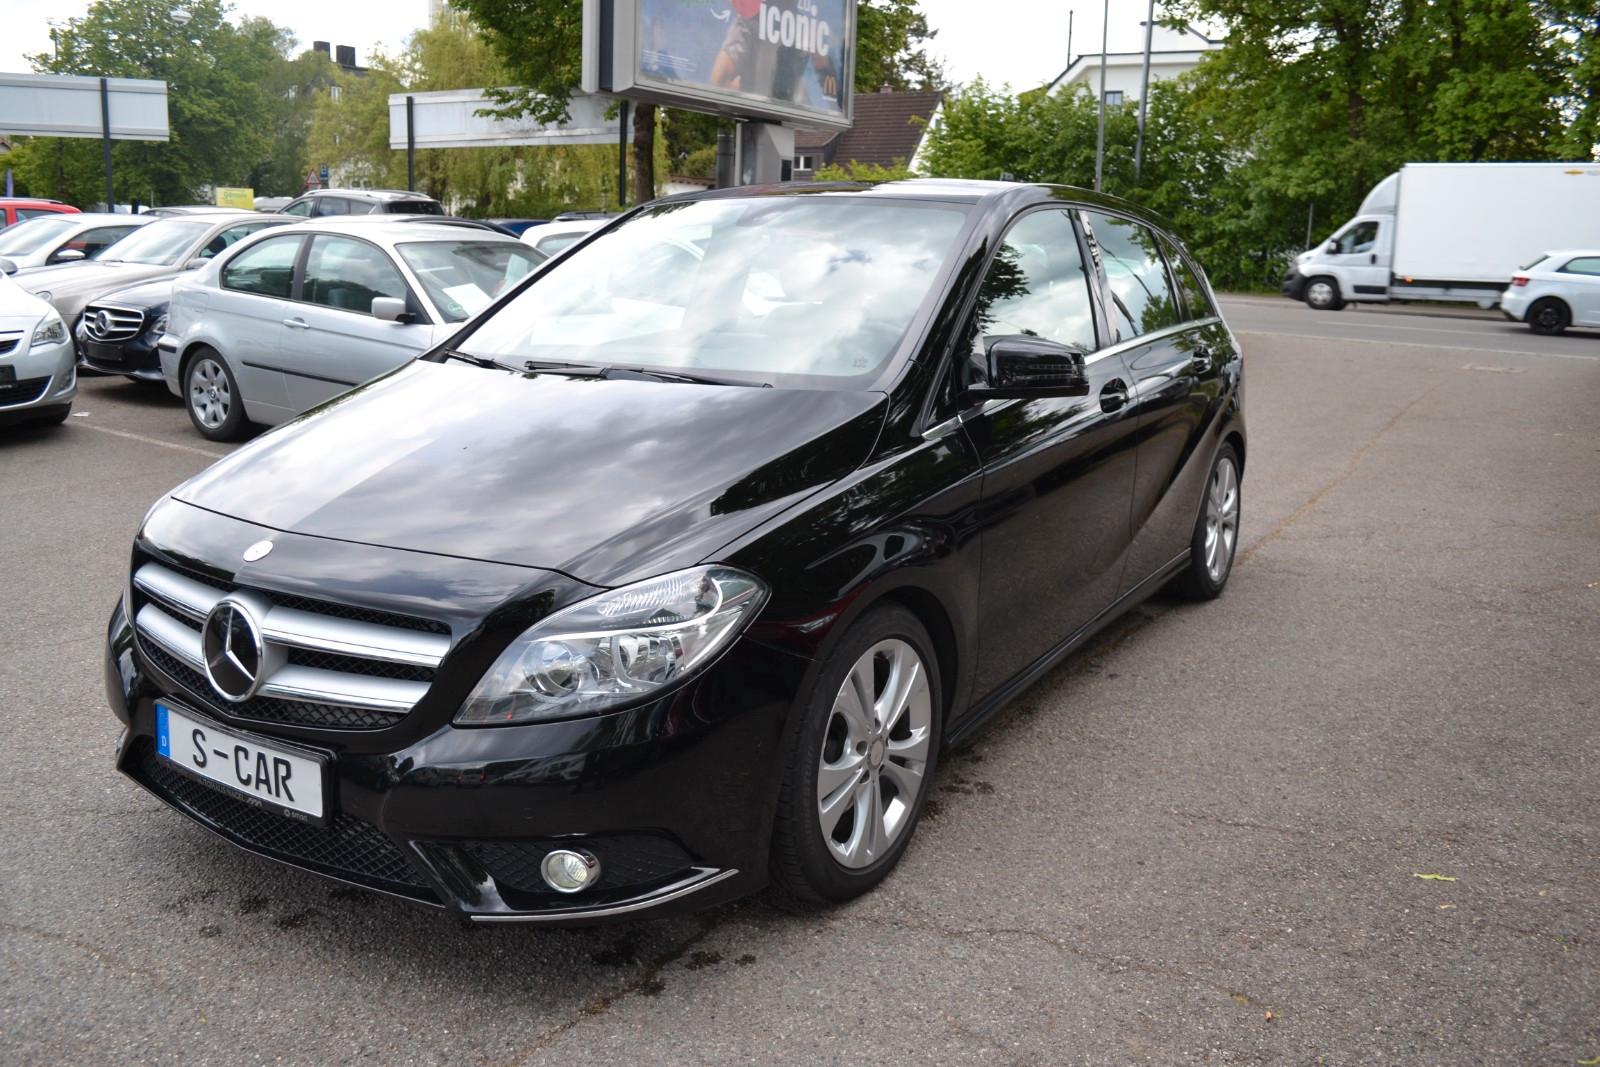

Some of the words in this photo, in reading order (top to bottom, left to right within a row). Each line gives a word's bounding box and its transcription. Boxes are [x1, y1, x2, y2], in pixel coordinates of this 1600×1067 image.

[759, 0, 830, 56] iconic
[161, 735, 167, 748] D
[192, 728, 295, 802] S-CAR
